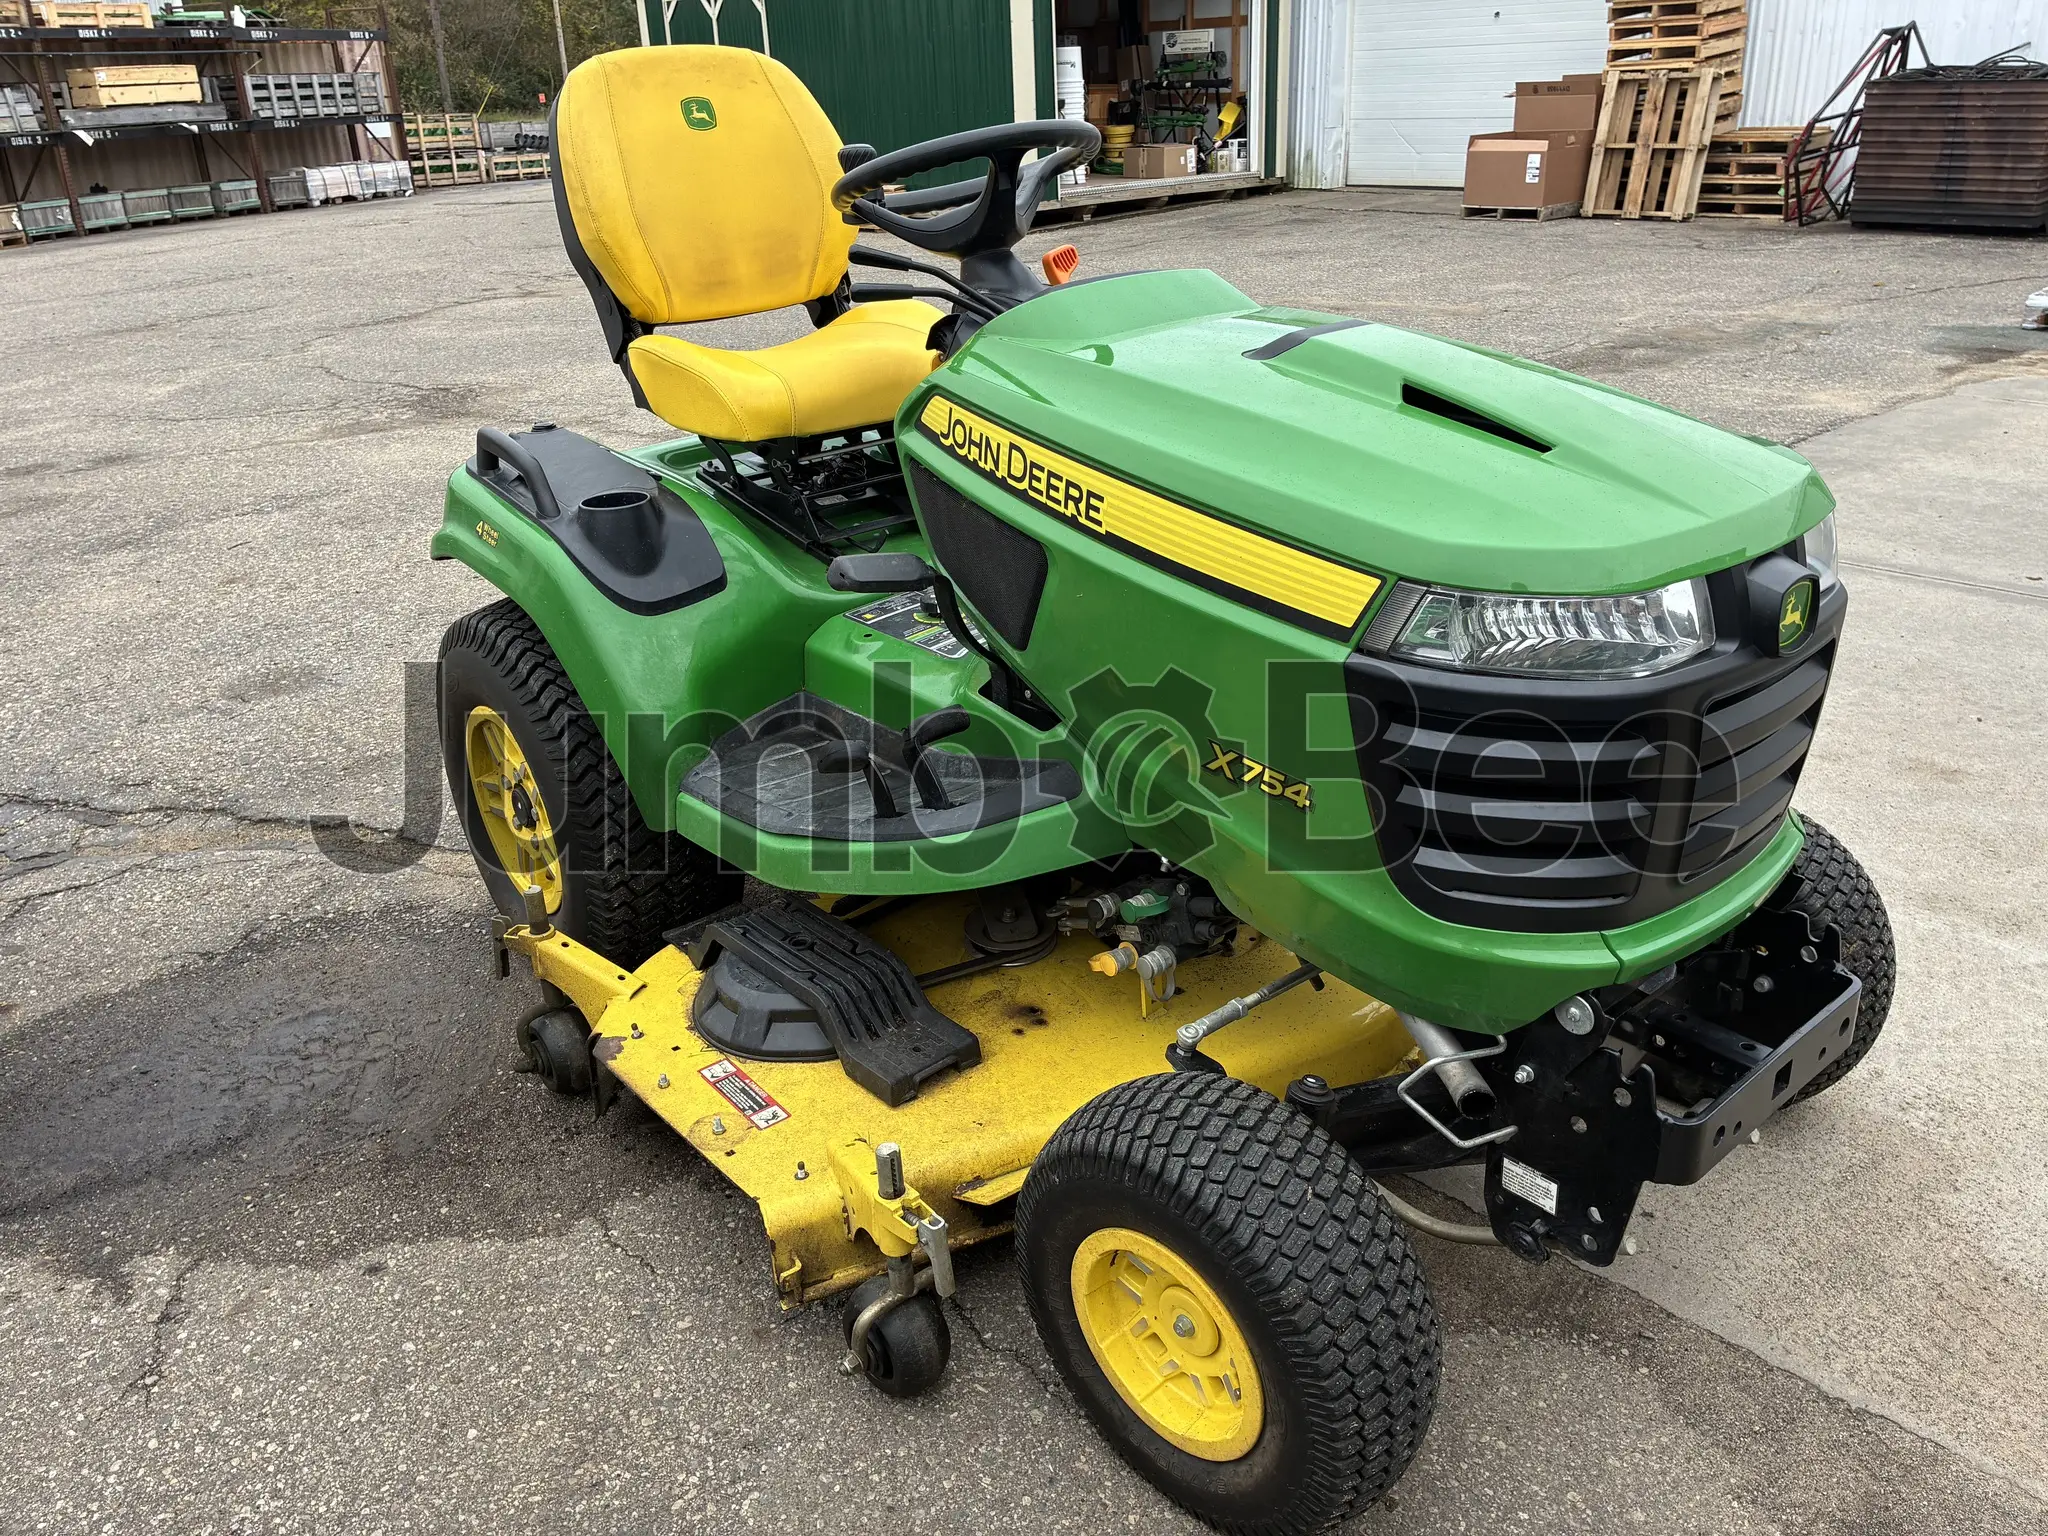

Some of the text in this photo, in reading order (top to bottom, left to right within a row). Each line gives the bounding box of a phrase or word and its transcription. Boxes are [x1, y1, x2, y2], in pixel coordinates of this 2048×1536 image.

[939, 406, 1105, 529] JOHN DEERE
[476, 520, 484, 535] 4
[1203, 740, 1312, 809] X754
